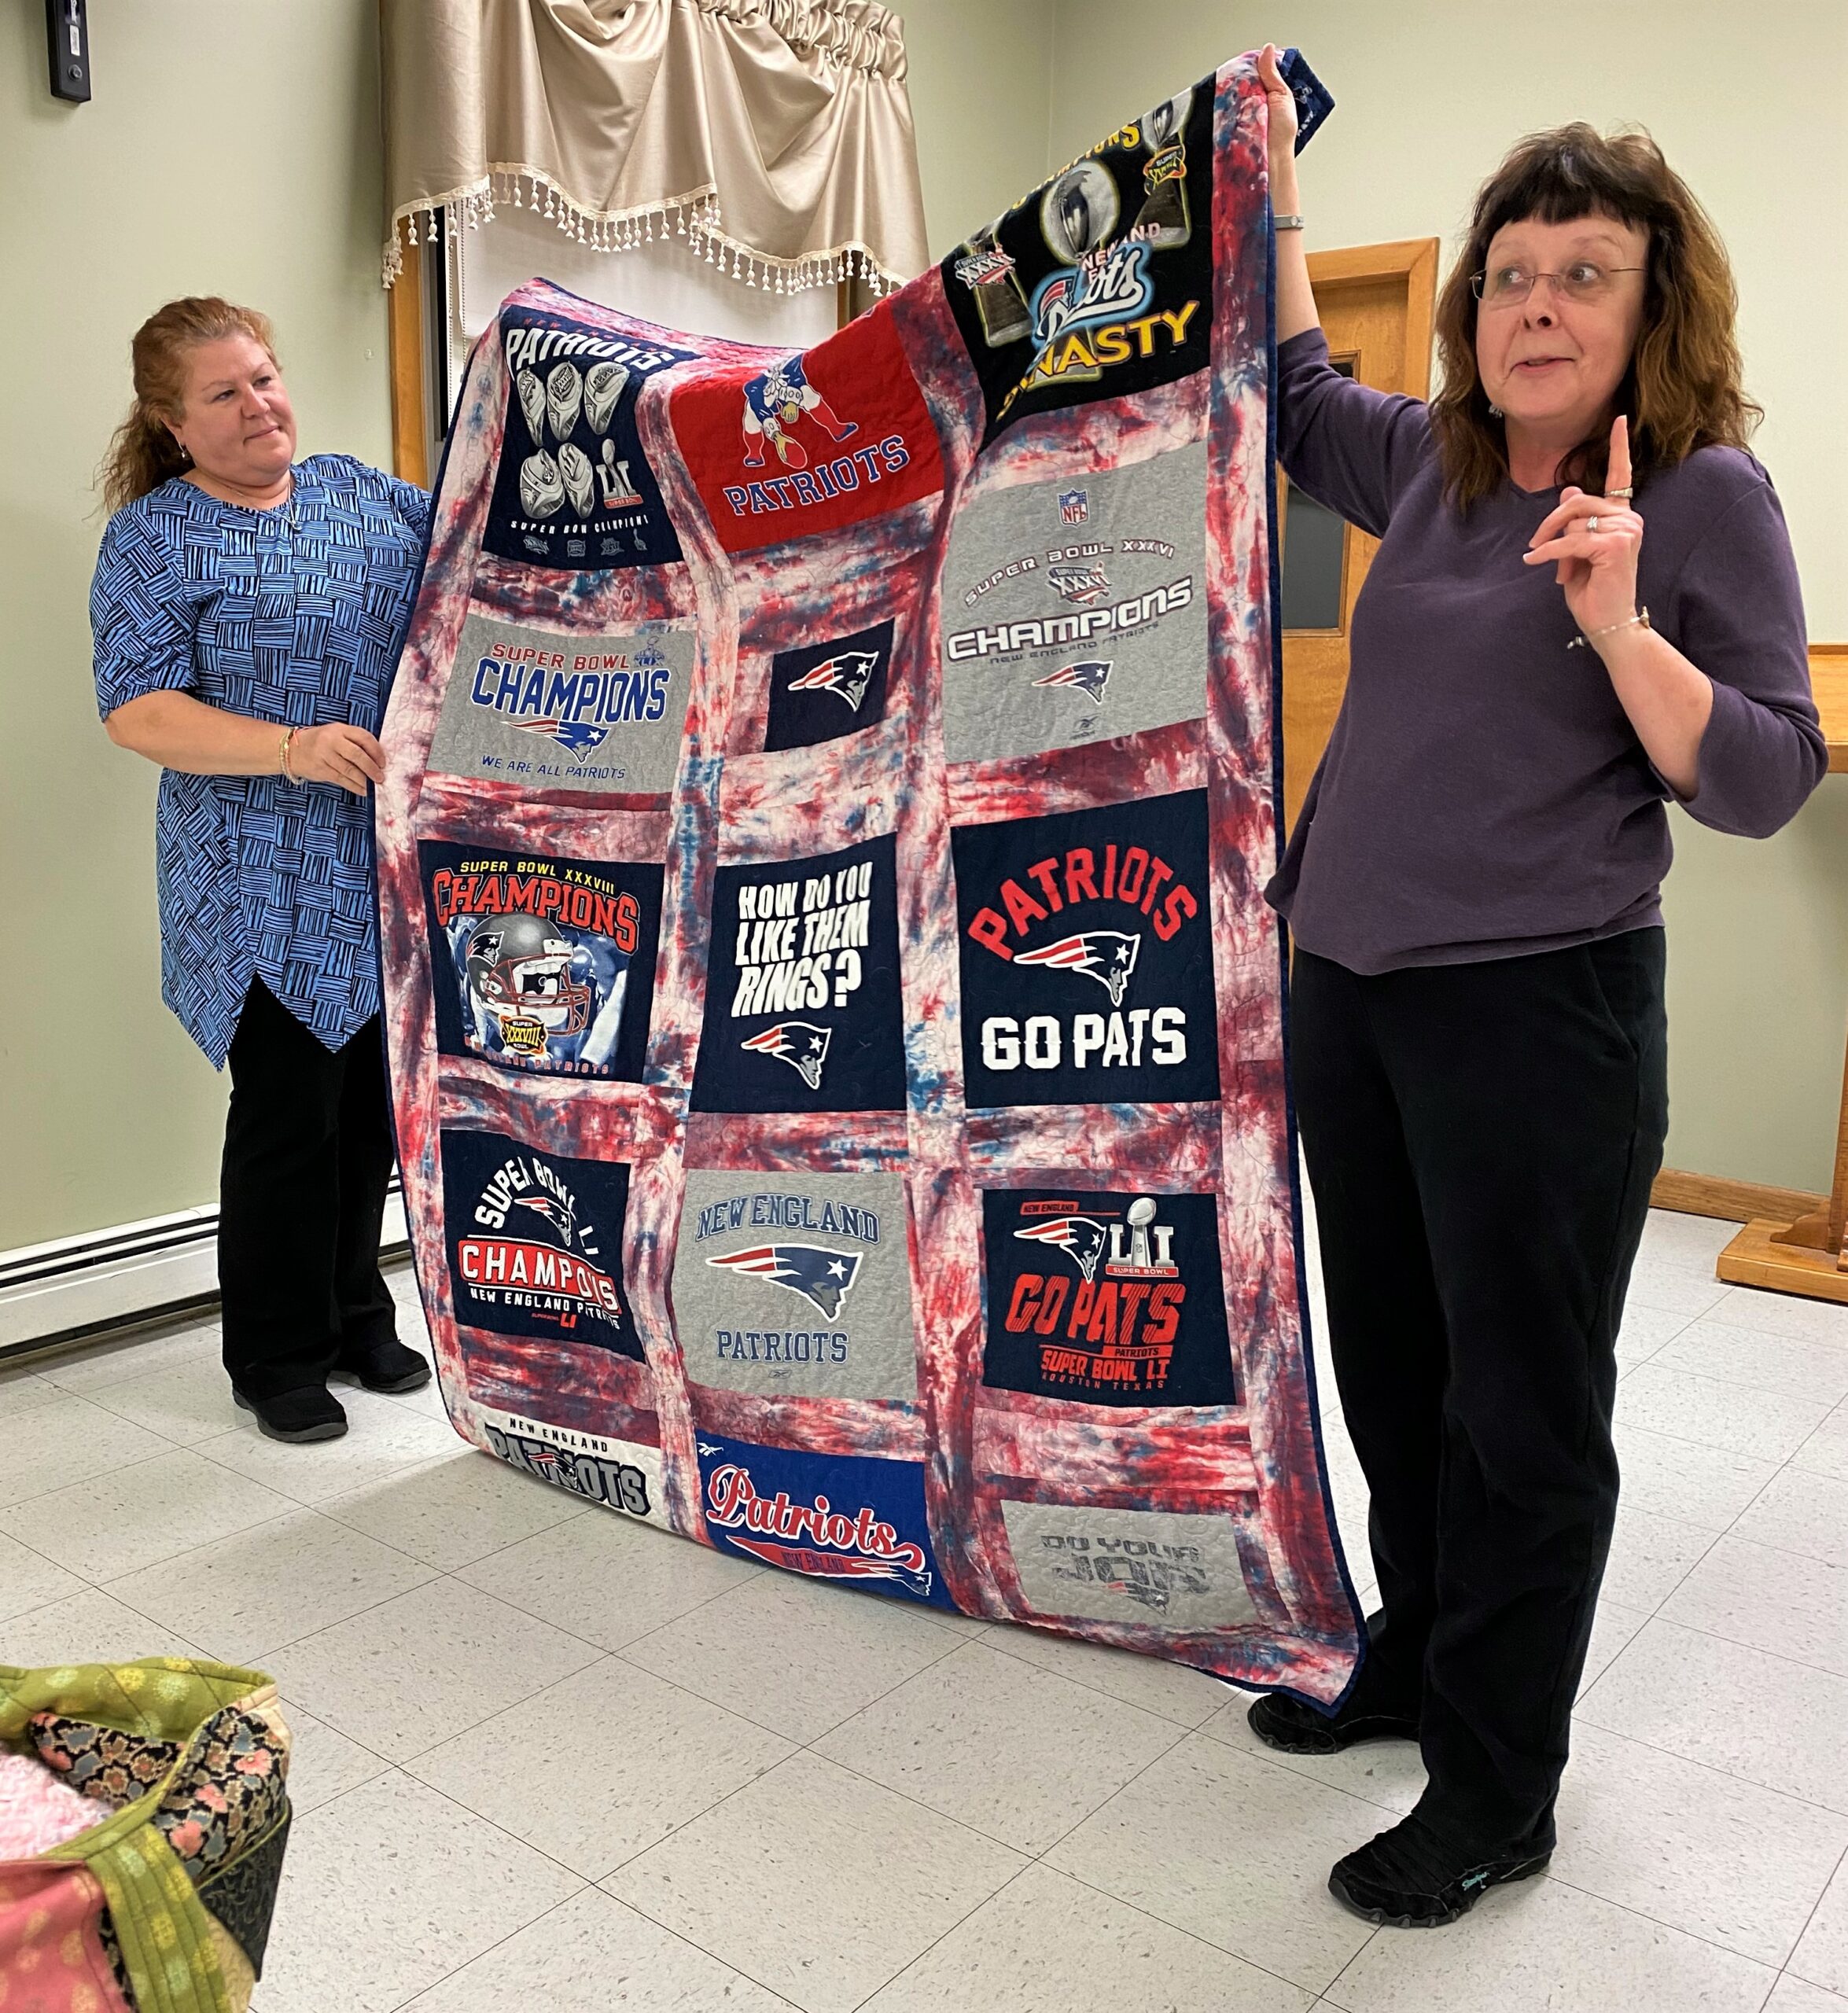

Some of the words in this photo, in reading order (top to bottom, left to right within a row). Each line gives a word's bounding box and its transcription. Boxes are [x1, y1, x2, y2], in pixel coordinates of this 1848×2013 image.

[506, 327, 676, 381] PATRIOTS
[723, 435, 911, 516] PATRIOTS
[510, 520, 555, 535] SUPER
[1062, 503, 1088, 524] NFL
[964, 556, 1038, 607] SUPER
[1047, 543, 1114, 564] BOWL
[1121, 539, 1175, 559] XXXVI
[948, 575, 1193, 661] CHAMPIONS
[491, 642, 565, 669] SUPER
[572, 654, 631, 672] BOWL
[989, 653, 1022, 664] NEW
[1029, 641, 1098, 658] ENGLAND
[469, 656, 672, 724] CHAMPIONS
[481, 754, 502, 769] WE
[506, 760, 532, 774] ARE
[536, 764, 561, 777] ALL
[565, 765, 626, 779] PATRIOTS
[460, 861, 509, 874] SUPER
[517, 861, 557, 878] BOWL
[564, 868, 615, 895] XXXVIII
[738, 881, 799, 920] HOW
[802, 874, 831, 913] DO
[835, 862, 874, 904] YOU
[433, 867, 641, 956] CHAMPIONS
[967, 844, 1198, 962] PATRIOTS
[734, 916, 801, 966] LIKE
[801, 899, 871, 957] THEM
[731, 948, 863, 1018] RINGS?
[505, 1023, 542, 1047] XXXVIII
[981, 1015, 1062, 1070] GO
[1072, 1006, 1187, 1069] PATS
[695, 1194, 750, 1242] NEW
[749, 1192, 882, 1246] ENGLAND
[1108, 1224, 1175, 1268] LI
[470, 1287, 496, 1304] NEW
[504, 1291, 570, 1312] ENGLAND
[1005, 1273, 1070, 1335] GO
[1066, 1279, 1187, 1345] PATS
[716, 1329, 849, 1364] PATRIOTS
[1040, 1349, 1088, 1376] SUPER
[1091, 1358, 1138, 1382] BOWL
[1147, 1359, 1170, 1380] LI
[1114, 1347, 1159, 1357] PATRIOTS
[1041, 1373, 1101, 1389] HOUSTON
[1113, 1380, 1165, 1391] TEXAS
[510, 1418, 535, 1433] NEW
[542, 1428, 608, 1452] ENGLAND
[484, 1422, 652, 1516] PATRIOTS
[705, 1463, 926, 1573] Patriots
[1040, 1535, 1091, 1551] DO
[1096, 1536, 1200, 1563] YOUR
